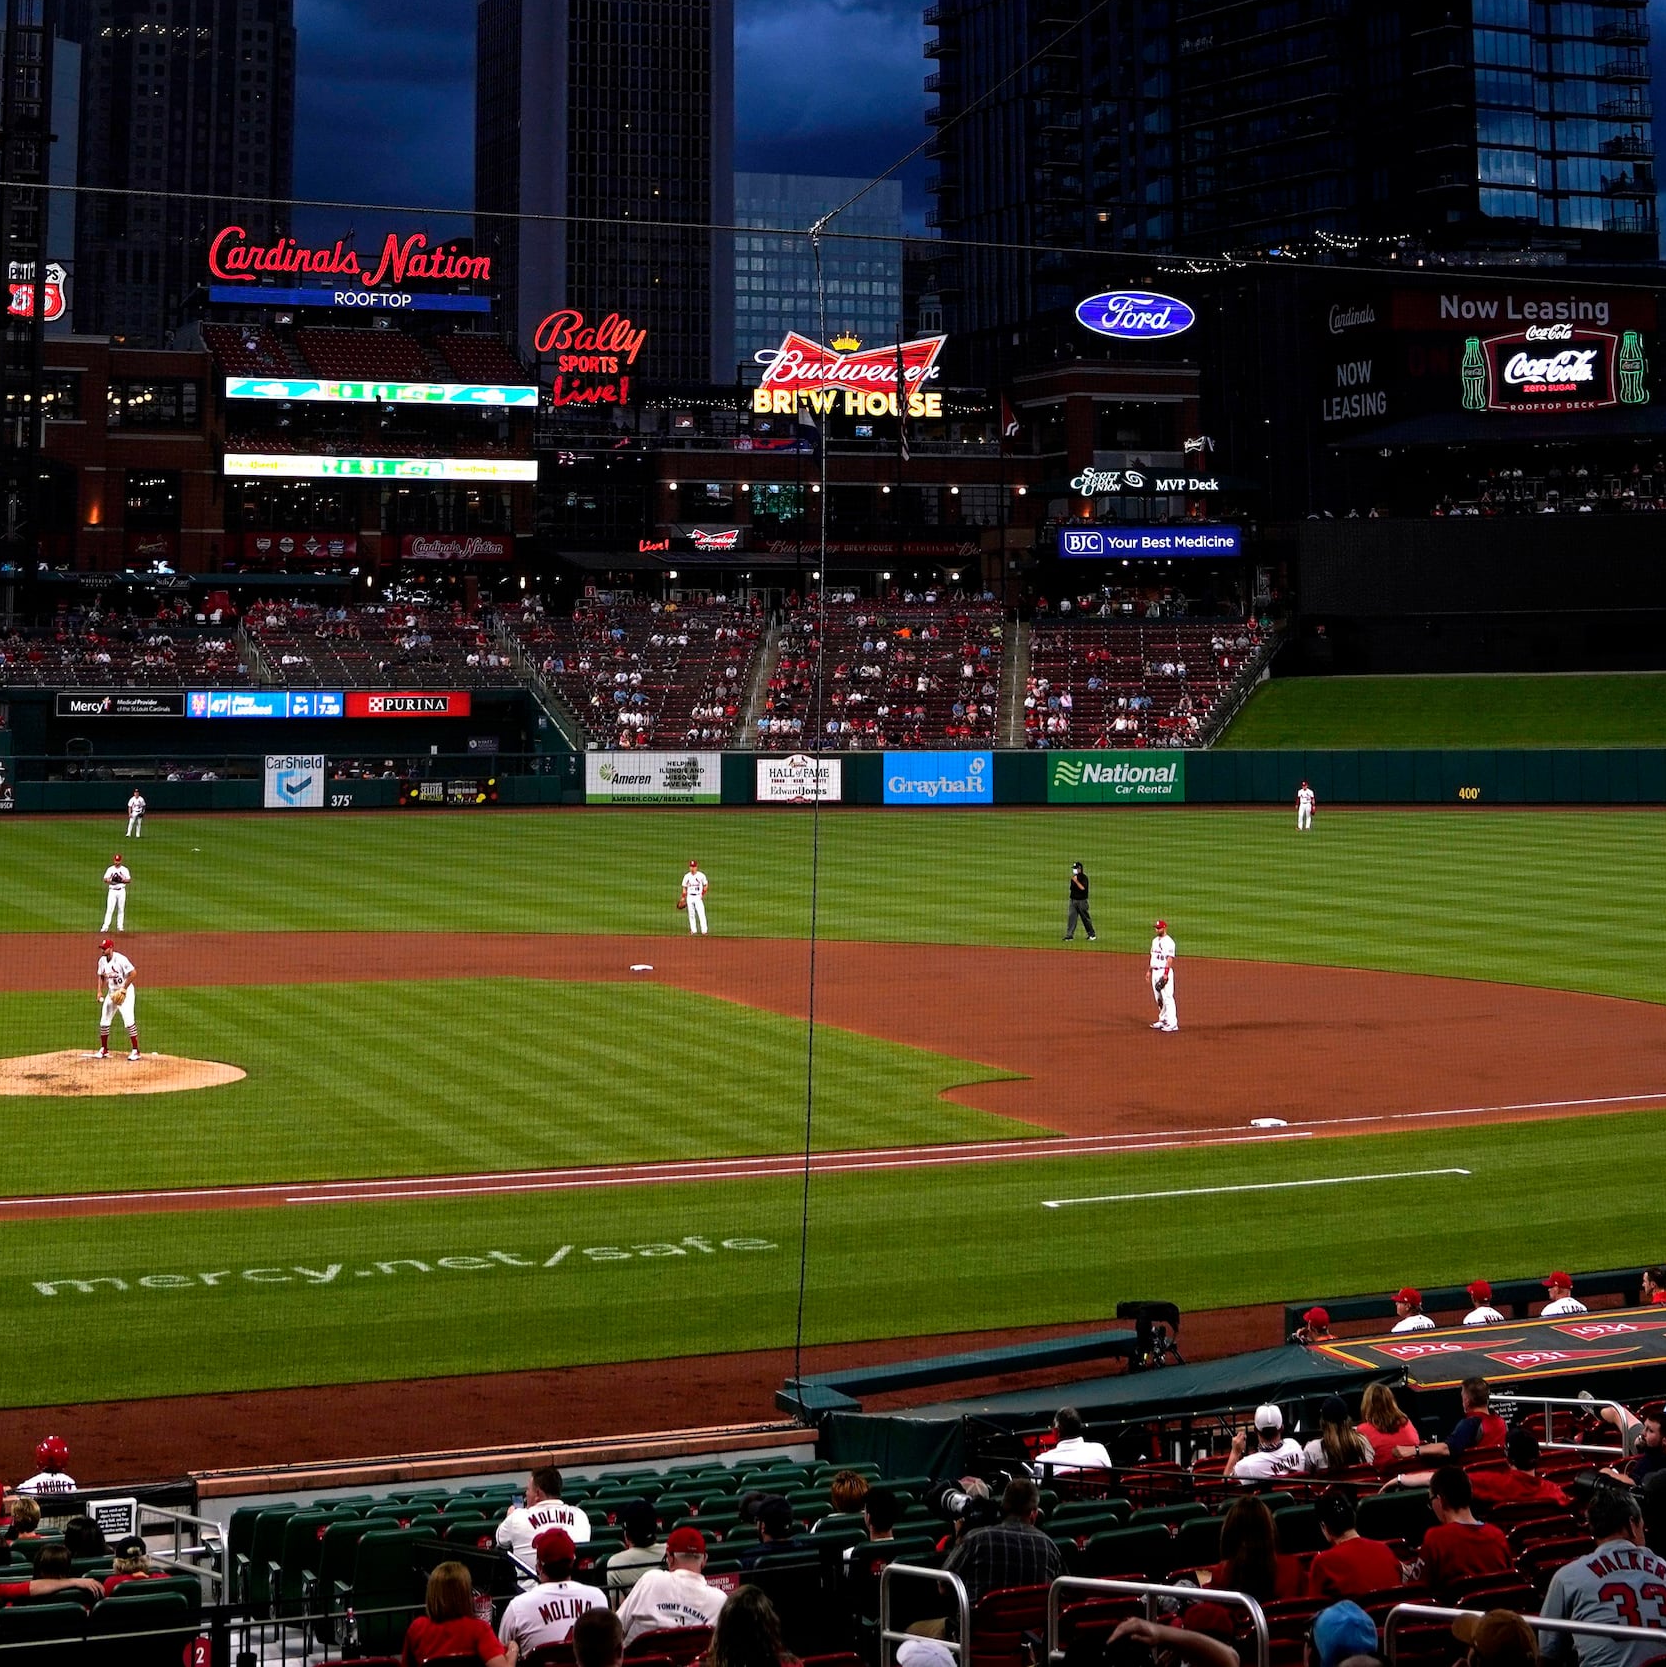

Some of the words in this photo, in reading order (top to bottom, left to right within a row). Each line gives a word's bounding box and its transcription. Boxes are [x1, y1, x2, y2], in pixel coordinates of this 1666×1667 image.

[209, 226, 360, 281] Cardinals
[361, 233, 491, 286] Nation
[334, 292, 412, 306] ROOFTOP
[1100, 296, 1172, 331] Ford
[1329, 303, 1376, 334] Cardinals
[1440, 295, 1499, 320] Now
[1507, 296, 1610, 325] Leasing
[534, 310, 646, 364] Bally
[559, 356, 618, 373] SPORTS
[1504, 349, 1597, 385] Coca-Cola
[1336, 359, 1372, 388] NOW
[553, 374, 628, 408] Live!
[1547, 384, 1577, 392] SUGAR
[1323, 391, 1387, 422] LEASING
[1510, 402, 1561, 412] ROOFTOP
[1566, 401, 1595, 410] DECK
[1156, 479, 1186, 491] MVP
[1189, 478, 1219, 491] Deck
[411, 536, 461, 556] Cardinals
[460, 537, 504, 556] Nation
[1070, 535, 1100, 550] BJC
[1107, 537, 1138, 549] Your
[1141, 536, 1172, 548] Best
[1174, 535, 1235, 548] Medicine
[71, 698, 103, 714] Mercy
[386, 698, 446, 711] PURINA
[266, 755, 323, 770] CarShield
[611, 773, 652, 785] Ameren
[769, 768, 795, 778] HALL
[803, 768, 830, 778] FAME
[1083, 763, 1177, 783] National
[1115, 784, 1134, 794] Car
[1137, 784, 1172, 794] Rental
[1458, 787, 1481, 801] 400'
[331, 795, 353, 807] 375'
[30, 1232, 781, 1298] mercy.net/safe
[1571, 1322, 1640, 1338] 1934
[1391, 1341, 1463, 1358] 1926
[1511, 1349, 1569, 1365] 1931
[527, 1506, 575, 1529] MOLINA
[1586, 1551, 1666, 1581] WALKER
